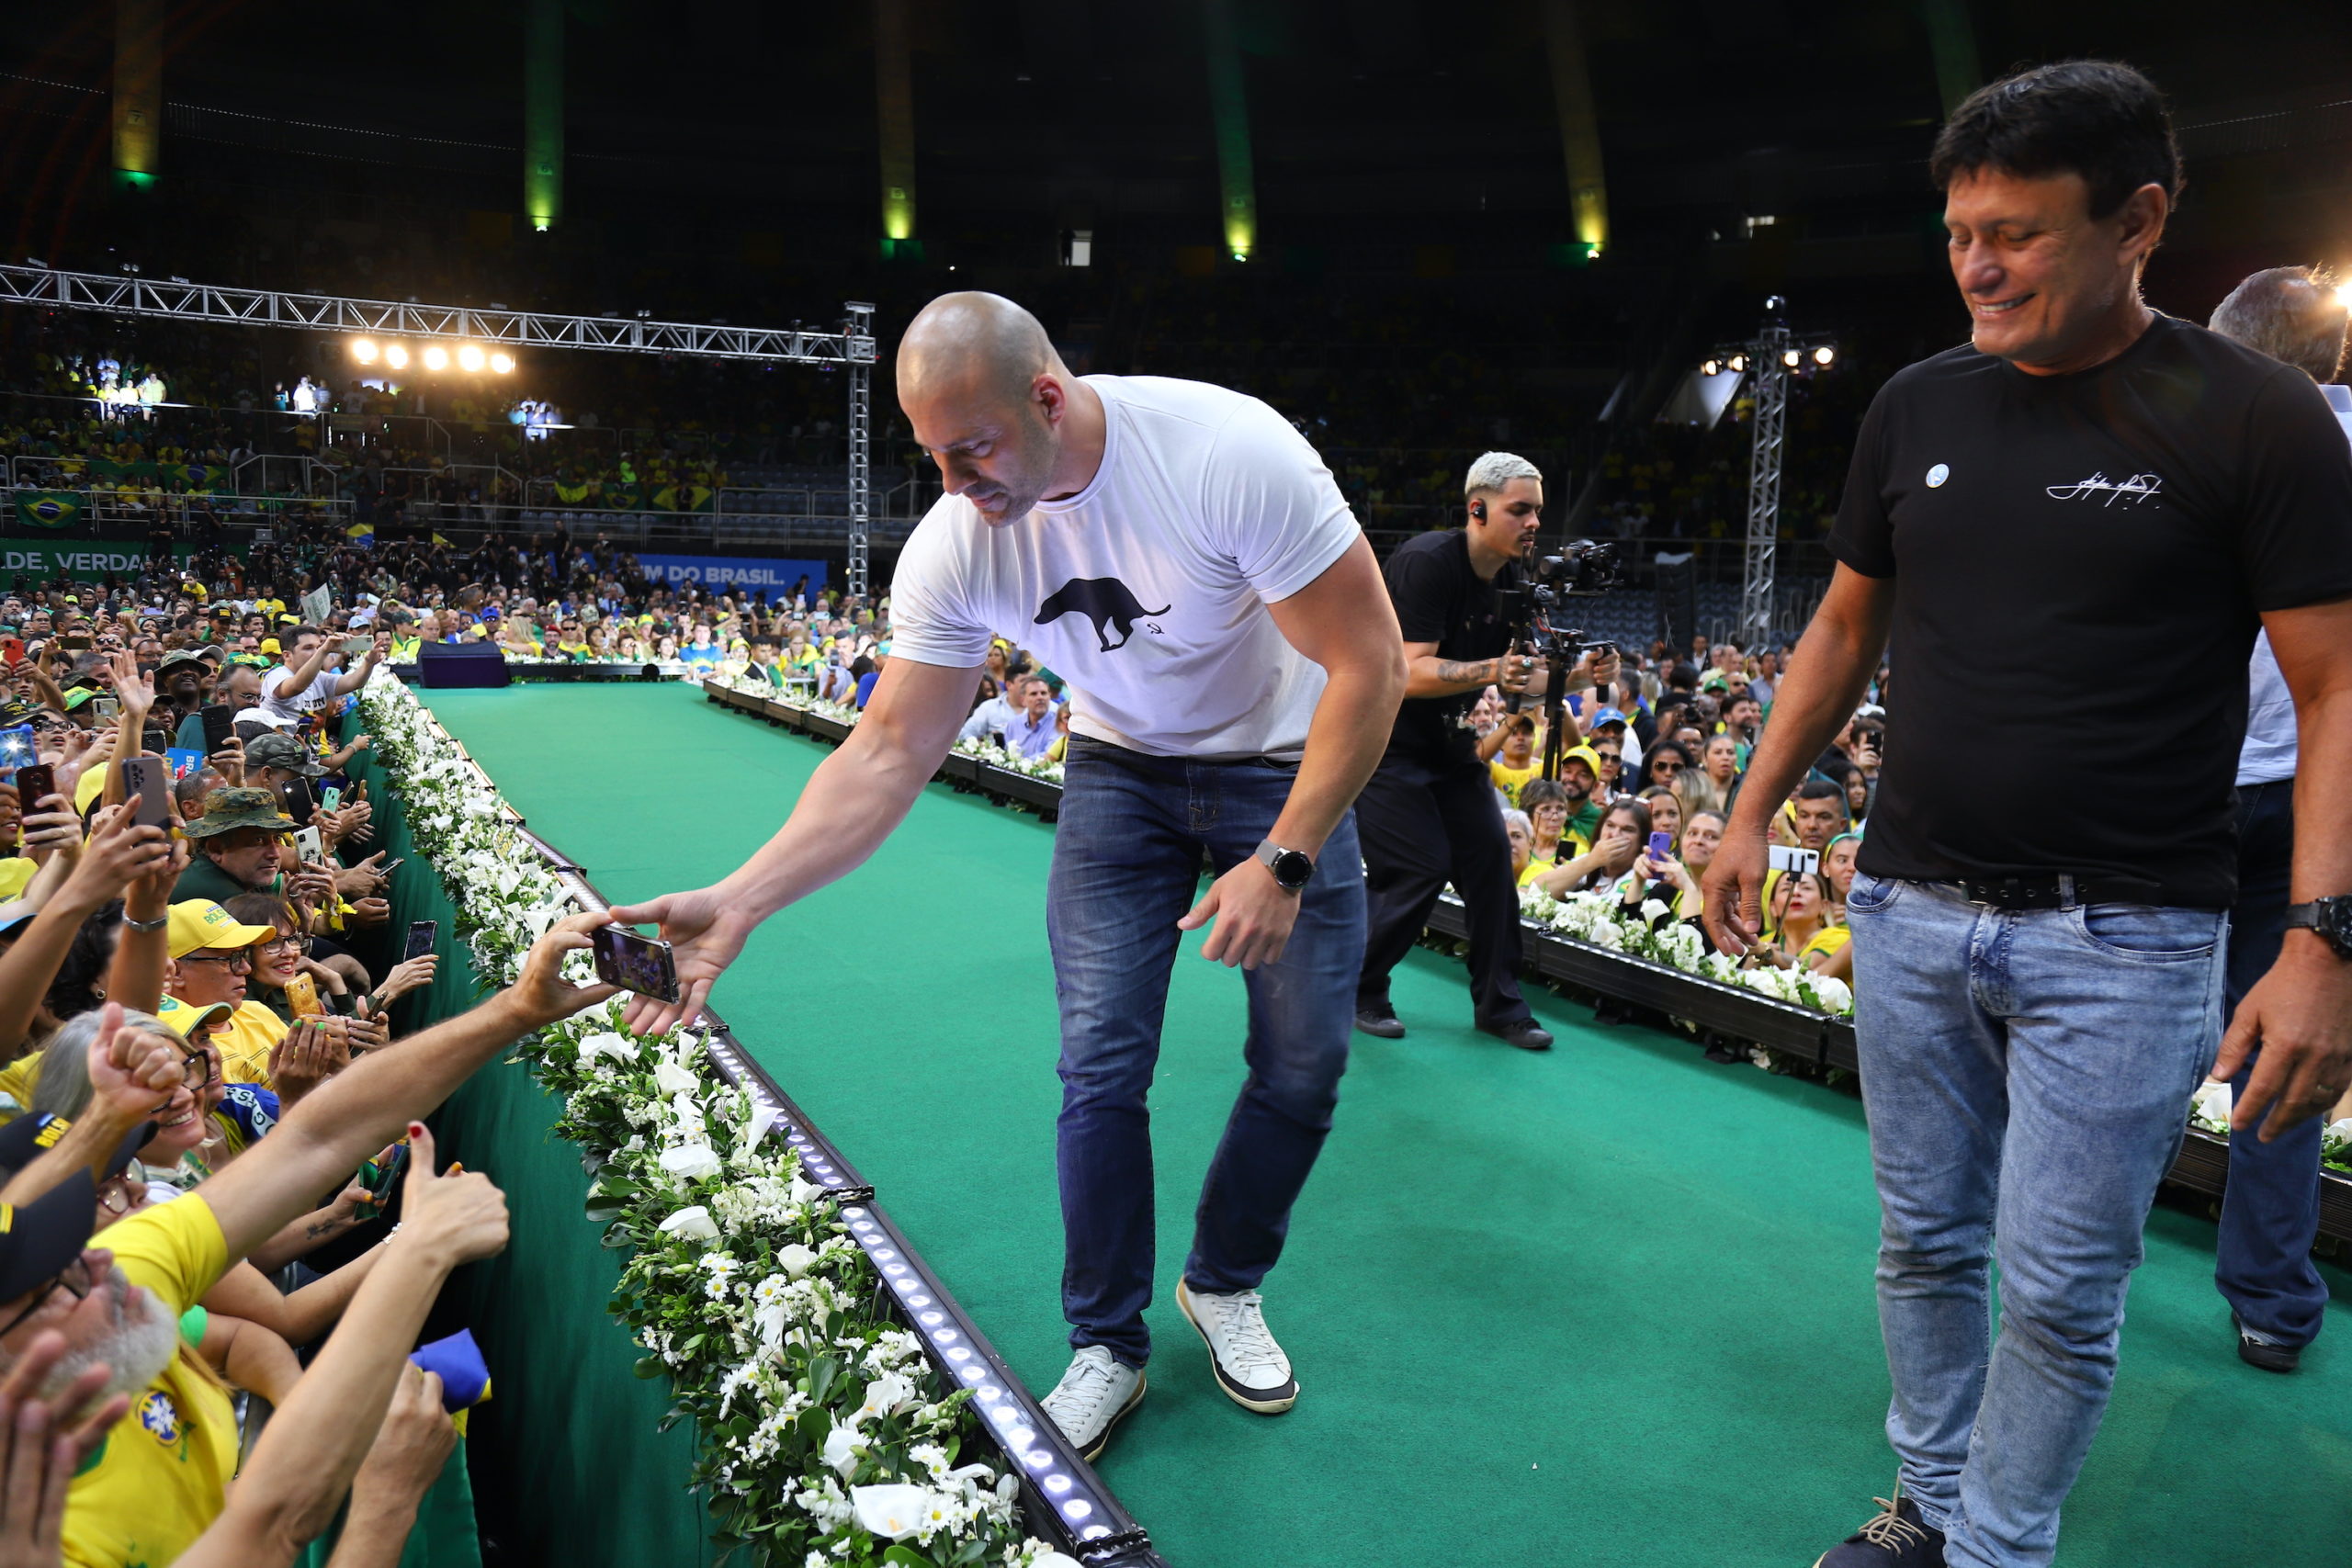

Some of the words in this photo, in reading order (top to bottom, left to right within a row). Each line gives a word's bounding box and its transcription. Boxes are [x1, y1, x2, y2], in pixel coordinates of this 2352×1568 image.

[1, 551, 49, 572] DE,
[668, 565, 701, 582] DO
[705, 567, 785, 585] BRASIL.
